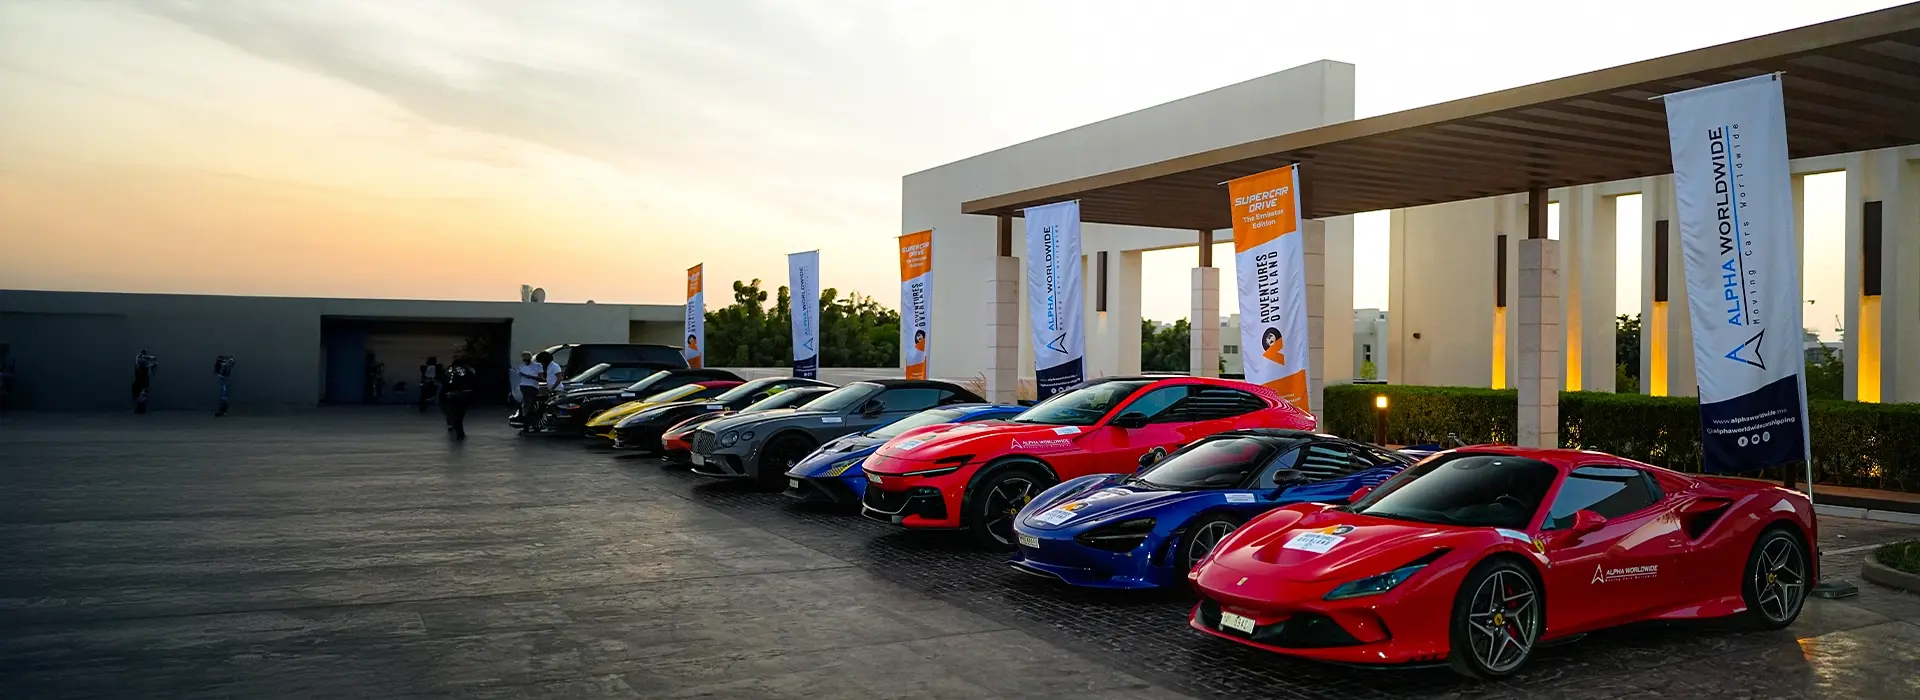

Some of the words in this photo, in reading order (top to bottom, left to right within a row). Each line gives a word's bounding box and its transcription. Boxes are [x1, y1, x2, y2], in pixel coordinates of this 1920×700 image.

[1733, 123, 1747, 208] Worldwide
[1234, 186, 1289, 207] SUPERCAR
[1248, 198, 1278, 213] DRIVE
[1708, 127, 1734, 255] WORLDWIDE
[1243, 215, 1255, 223] The
[1255, 209, 1284, 220] Emirates
[1252, 219, 1276, 229] Edition
[1743, 221, 1753, 256] Cars
[1043, 226, 1053, 293] WORLDWIDE
[1255, 253, 1271, 324] ADVENTURES
[1268, 251, 1281, 322] OVERLAND
[1722, 258, 1742, 326] ALPHA
[1748, 269, 1760, 325] Moving
[1047, 295, 1056, 331] ALPHA
[1606, 568, 1625, 576] ALPHA
[1625, 564, 1658, 574] WORLDWIDE
